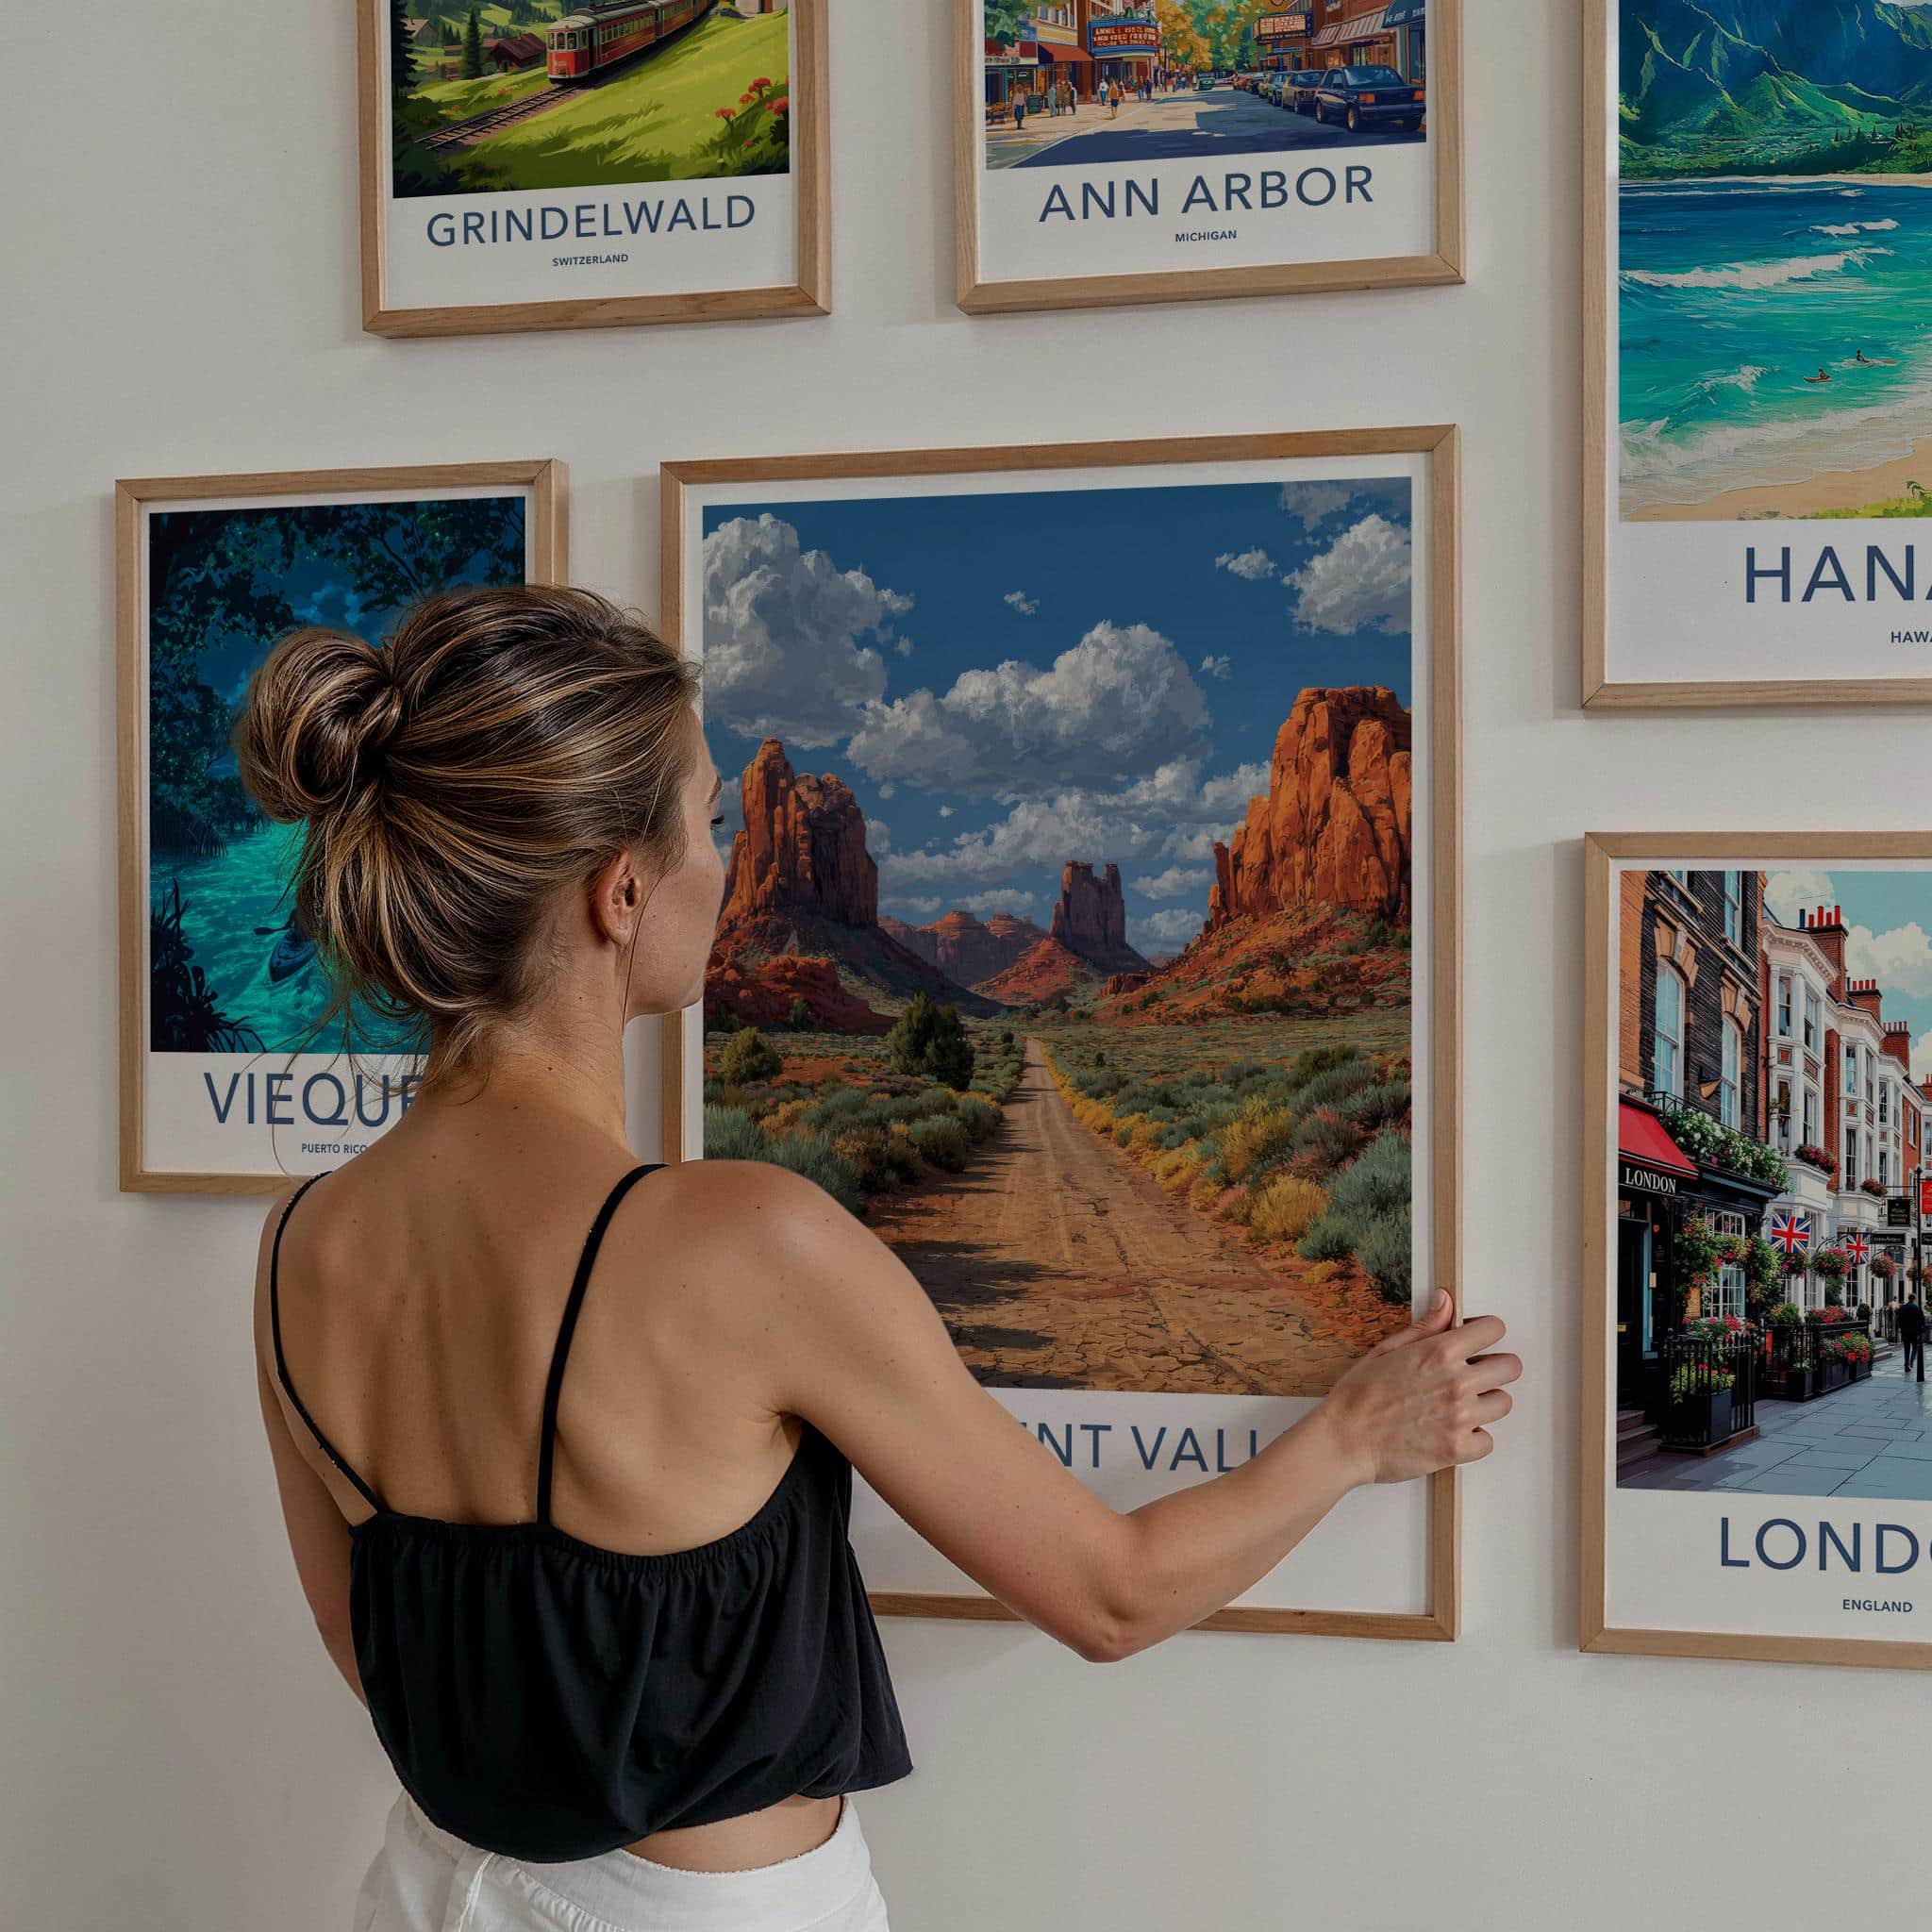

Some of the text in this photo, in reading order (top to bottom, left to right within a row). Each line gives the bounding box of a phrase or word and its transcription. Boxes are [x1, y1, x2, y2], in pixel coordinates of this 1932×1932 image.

[1039, 165, 1373, 222] ANN ARBOR
[427, 195, 755, 246] GRINDELWALD
[1175, 230, 1237, 242] MICHIGAN
[552, 254, 629, 267] SWITZERLAND
[1746, 544, 1932, 603] HAN
[1890, 630, 1932, 643] HAW
[301, 1143, 368, 1154] PUERTO RICO
[1625, 1167, 1676, 1194] LONDON
[1020, 1422, 1112, 1468] NT
[1721, 1517, 1932, 1574] LOND
[1842, 1599, 1913, 1613] ENGLAND
